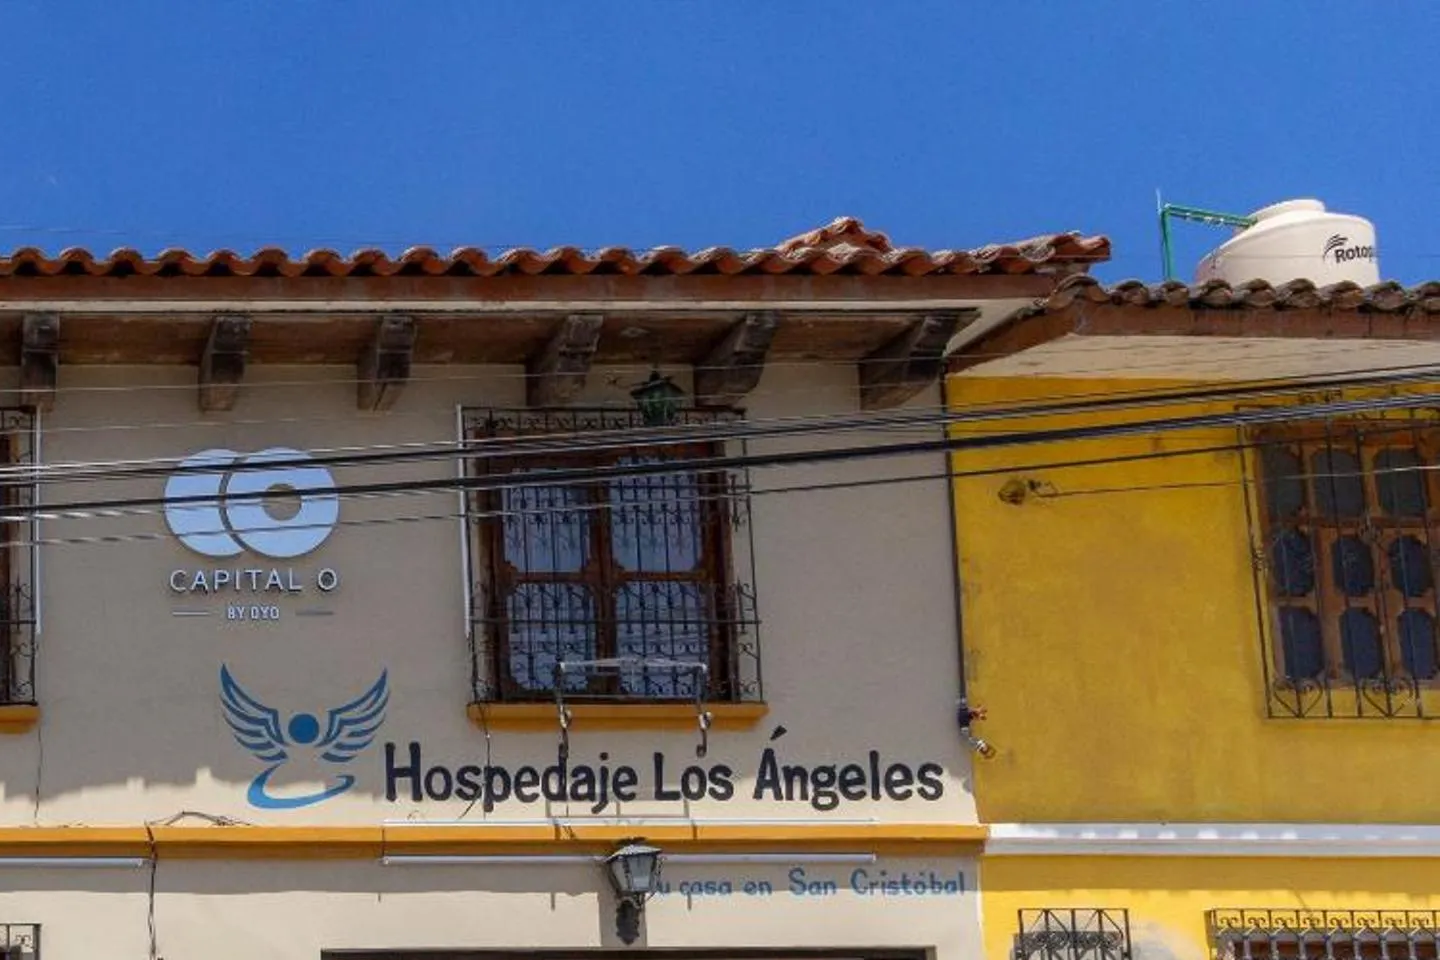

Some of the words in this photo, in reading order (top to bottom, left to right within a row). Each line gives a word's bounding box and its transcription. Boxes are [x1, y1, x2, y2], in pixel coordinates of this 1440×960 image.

[170, 568, 303, 592] CAPITAL
[317, 568, 338, 591] O
[227, 605, 245, 620] BY
[250, 605, 280, 620] OYO
[384, 741, 639, 814] Hospedaje
[653, 751, 734, 801] Los
[753, 725, 944, 811] Ángeles
[679, 880, 732, 896] casa
[743, 880, 773, 895] en
[788, 867, 837, 896] San
[850, 867, 965, 896] Cristóbal
